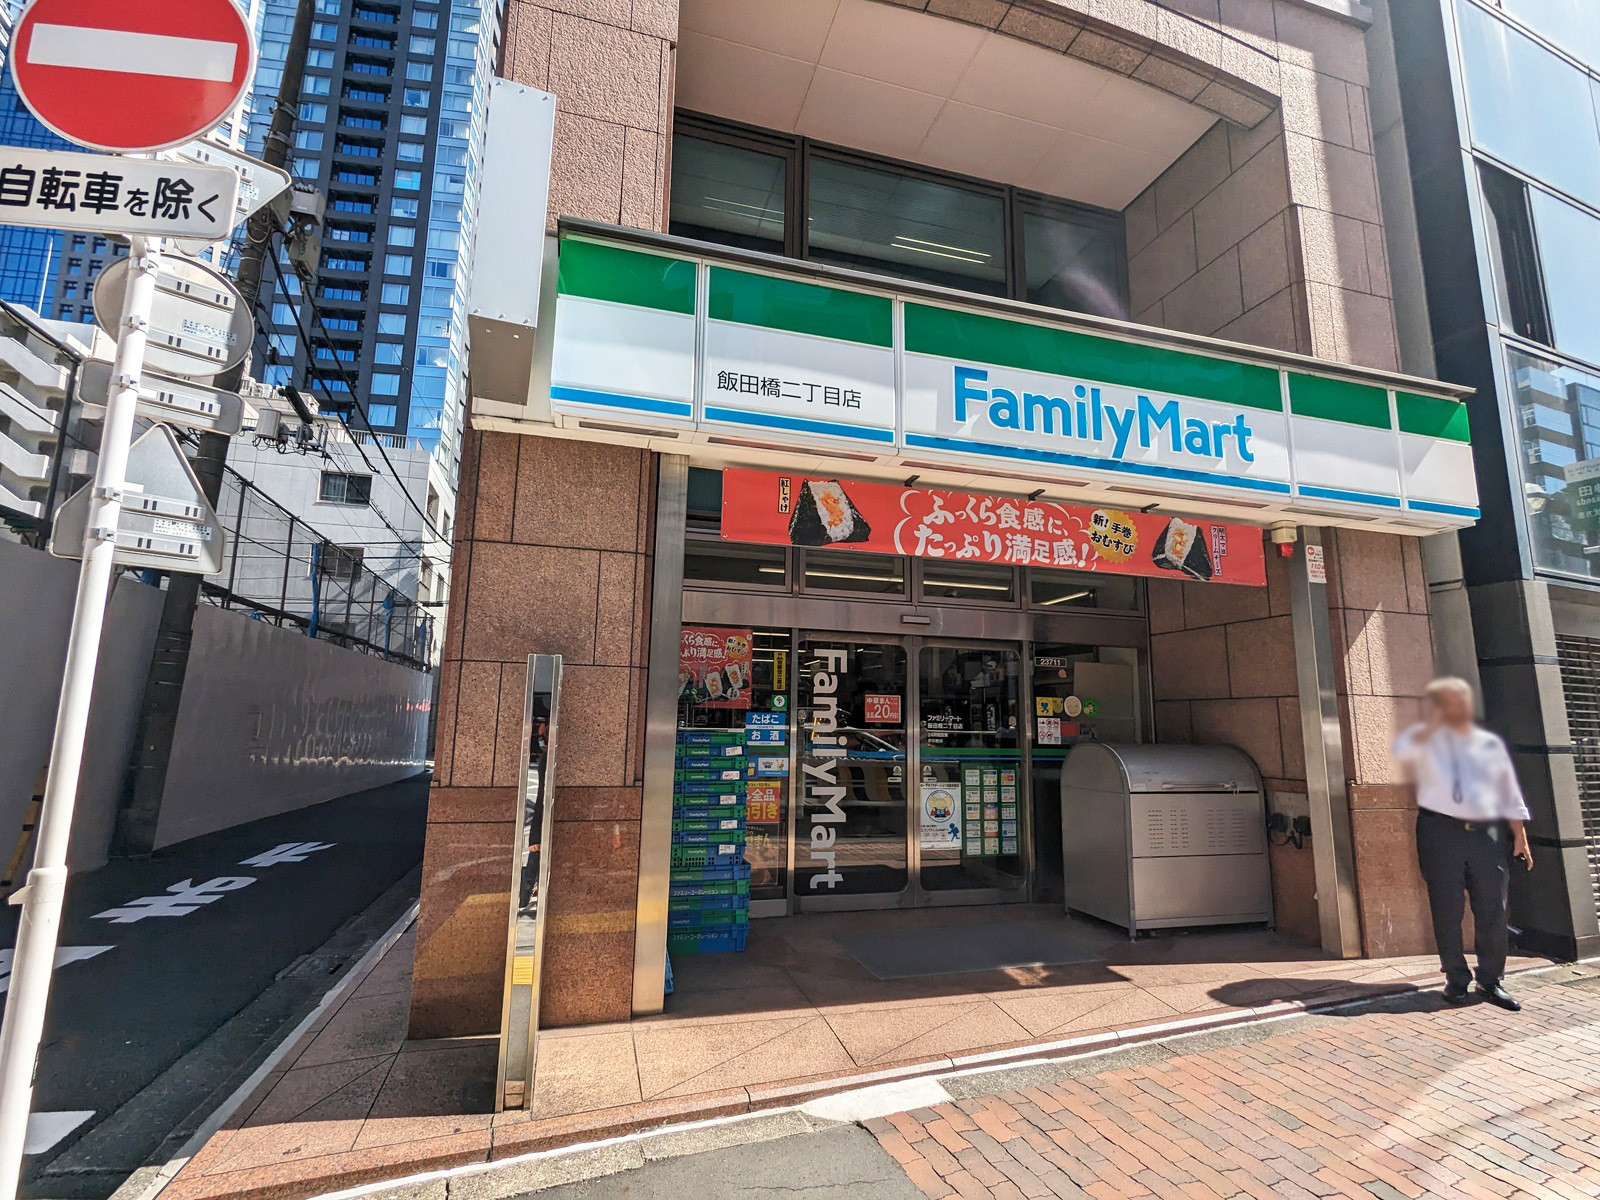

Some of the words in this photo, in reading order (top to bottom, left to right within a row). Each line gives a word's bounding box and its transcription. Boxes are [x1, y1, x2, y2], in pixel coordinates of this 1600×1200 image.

[0, 164, 219, 223] 自転車を除く
[717, 370, 862, 409] 飯田橋二丁目店
[953, 365, 1255, 462] FamilyMart
[780, 478, 790, 513] 紅しゃけ
[923, 495, 1069, 536] ふっくら食感に、
[1090, 531, 1135, 556] おむすび
[1212, 527, 1221, 575] クリームチーズ
[1218, 528, 1226, 555] 明太マヨ
[1040, 658, 1061, 666] 23711
[751, 730, 780, 741] お酒
[752, 713, 779, 724] たばこ
[802, 648, 848, 889] FamilyMart
